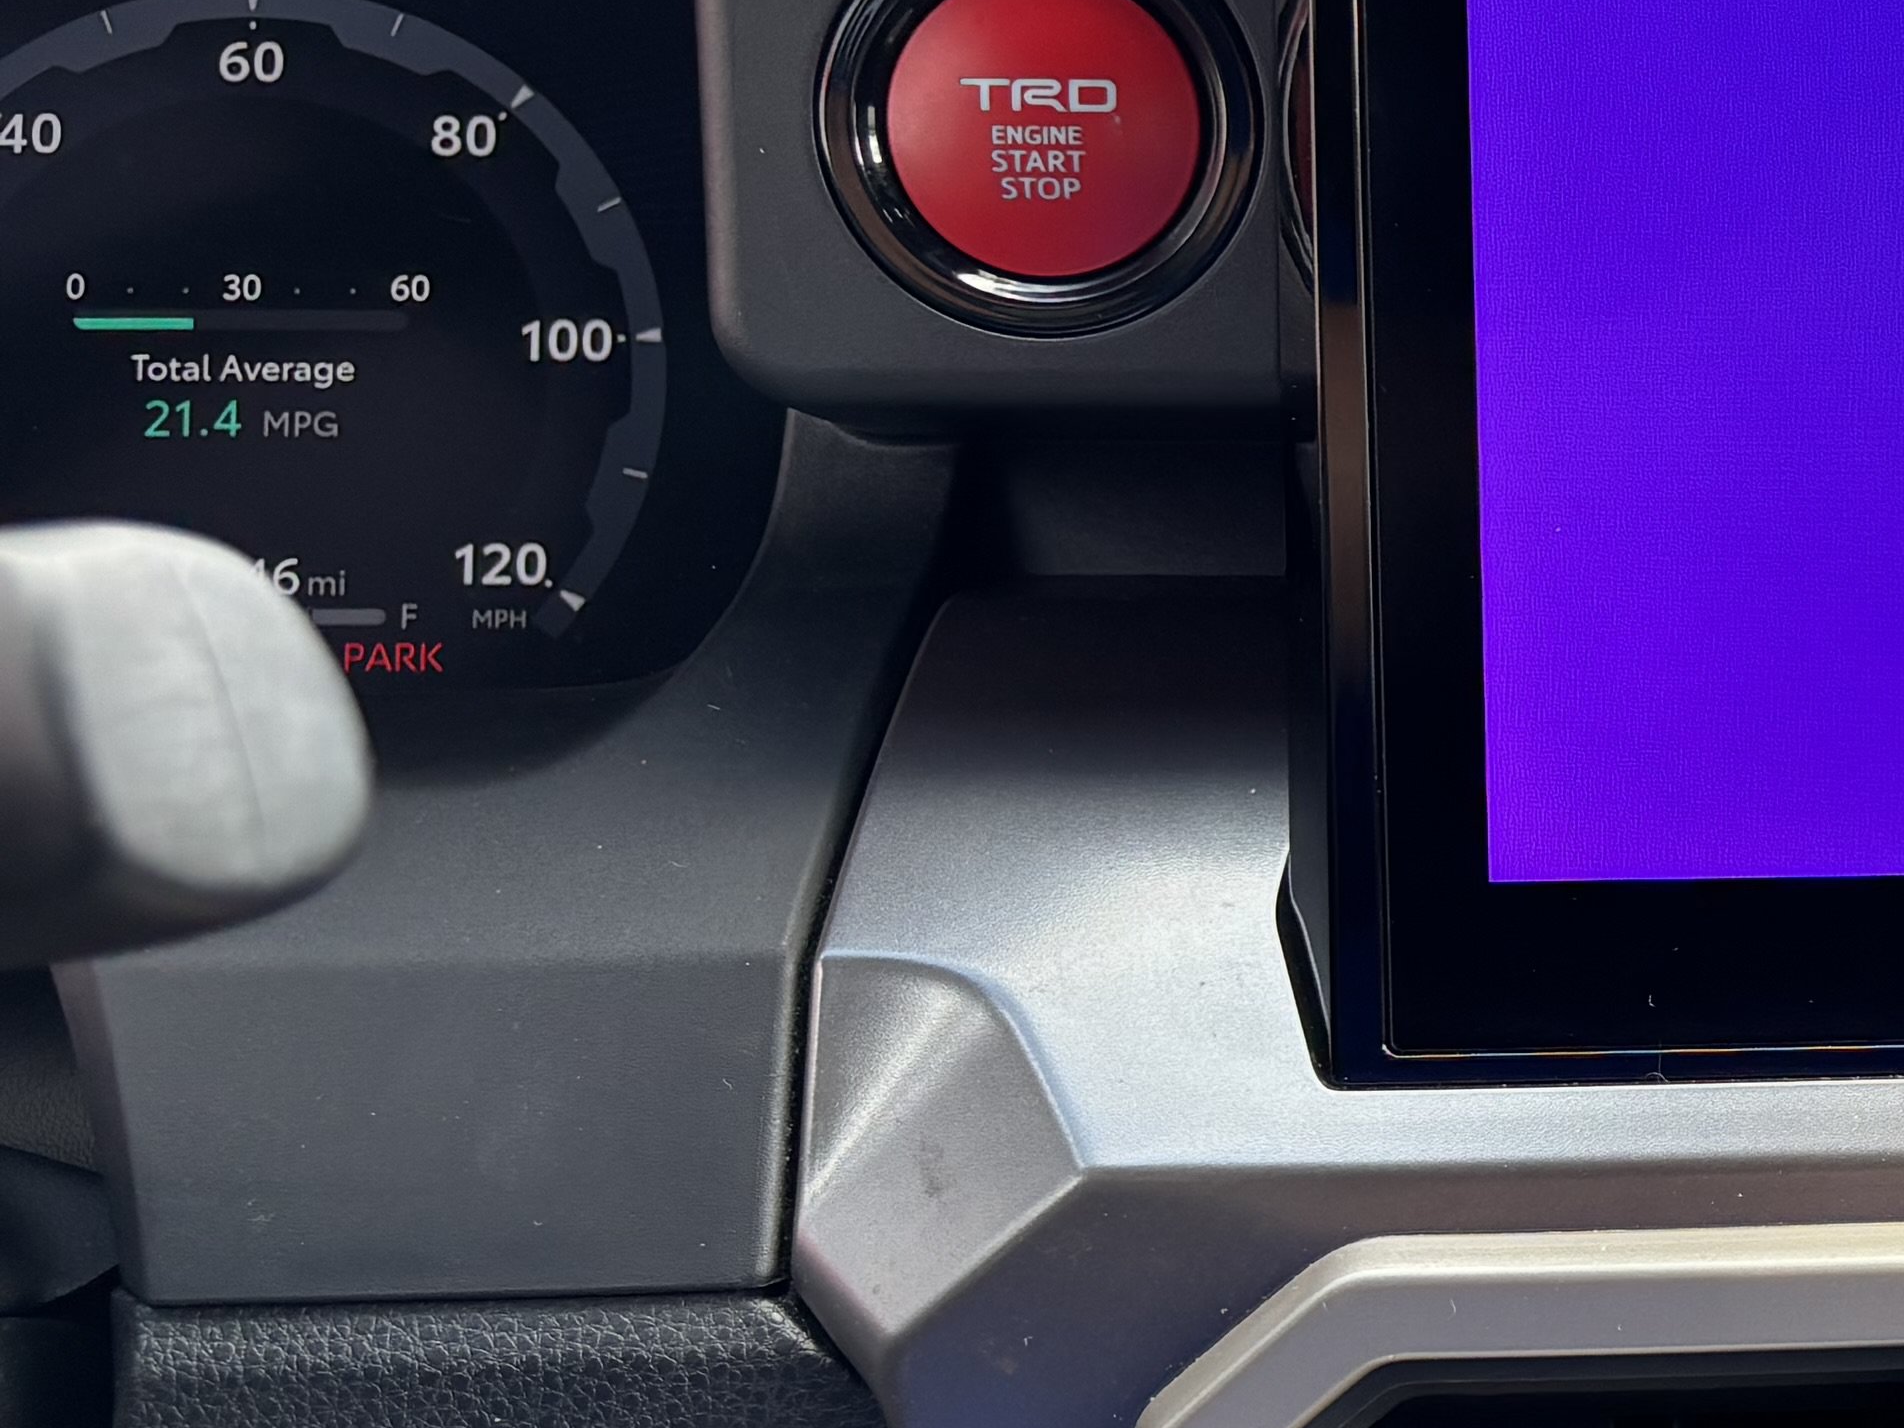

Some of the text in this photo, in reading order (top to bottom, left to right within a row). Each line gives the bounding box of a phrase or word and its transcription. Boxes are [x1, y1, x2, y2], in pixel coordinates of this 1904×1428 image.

[219, 41, 284, 83] 60
[960, 78, 1117, 113] TRD
[0, 113, 62, 155] 40
[431, 115, 497, 157] 80
[991, 124, 1083, 146] ENGINE
[991, 149, 1086, 173] START
[1001, 177, 1082, 200] STOP
[65, 272, 430, 303] 0 30 60
[521, 318, 612, 363] 100
[131, 353, 356, 390] Total Average
[144, 400, 339, 439] 21.4 MPG
[455, 543, 547, 586] 120
[307, 570, 346, 597] mi
[401, 603, 418, 630] F
[471, 609, 527, 629] MPH
[343, 642, 443, 673] PARK
